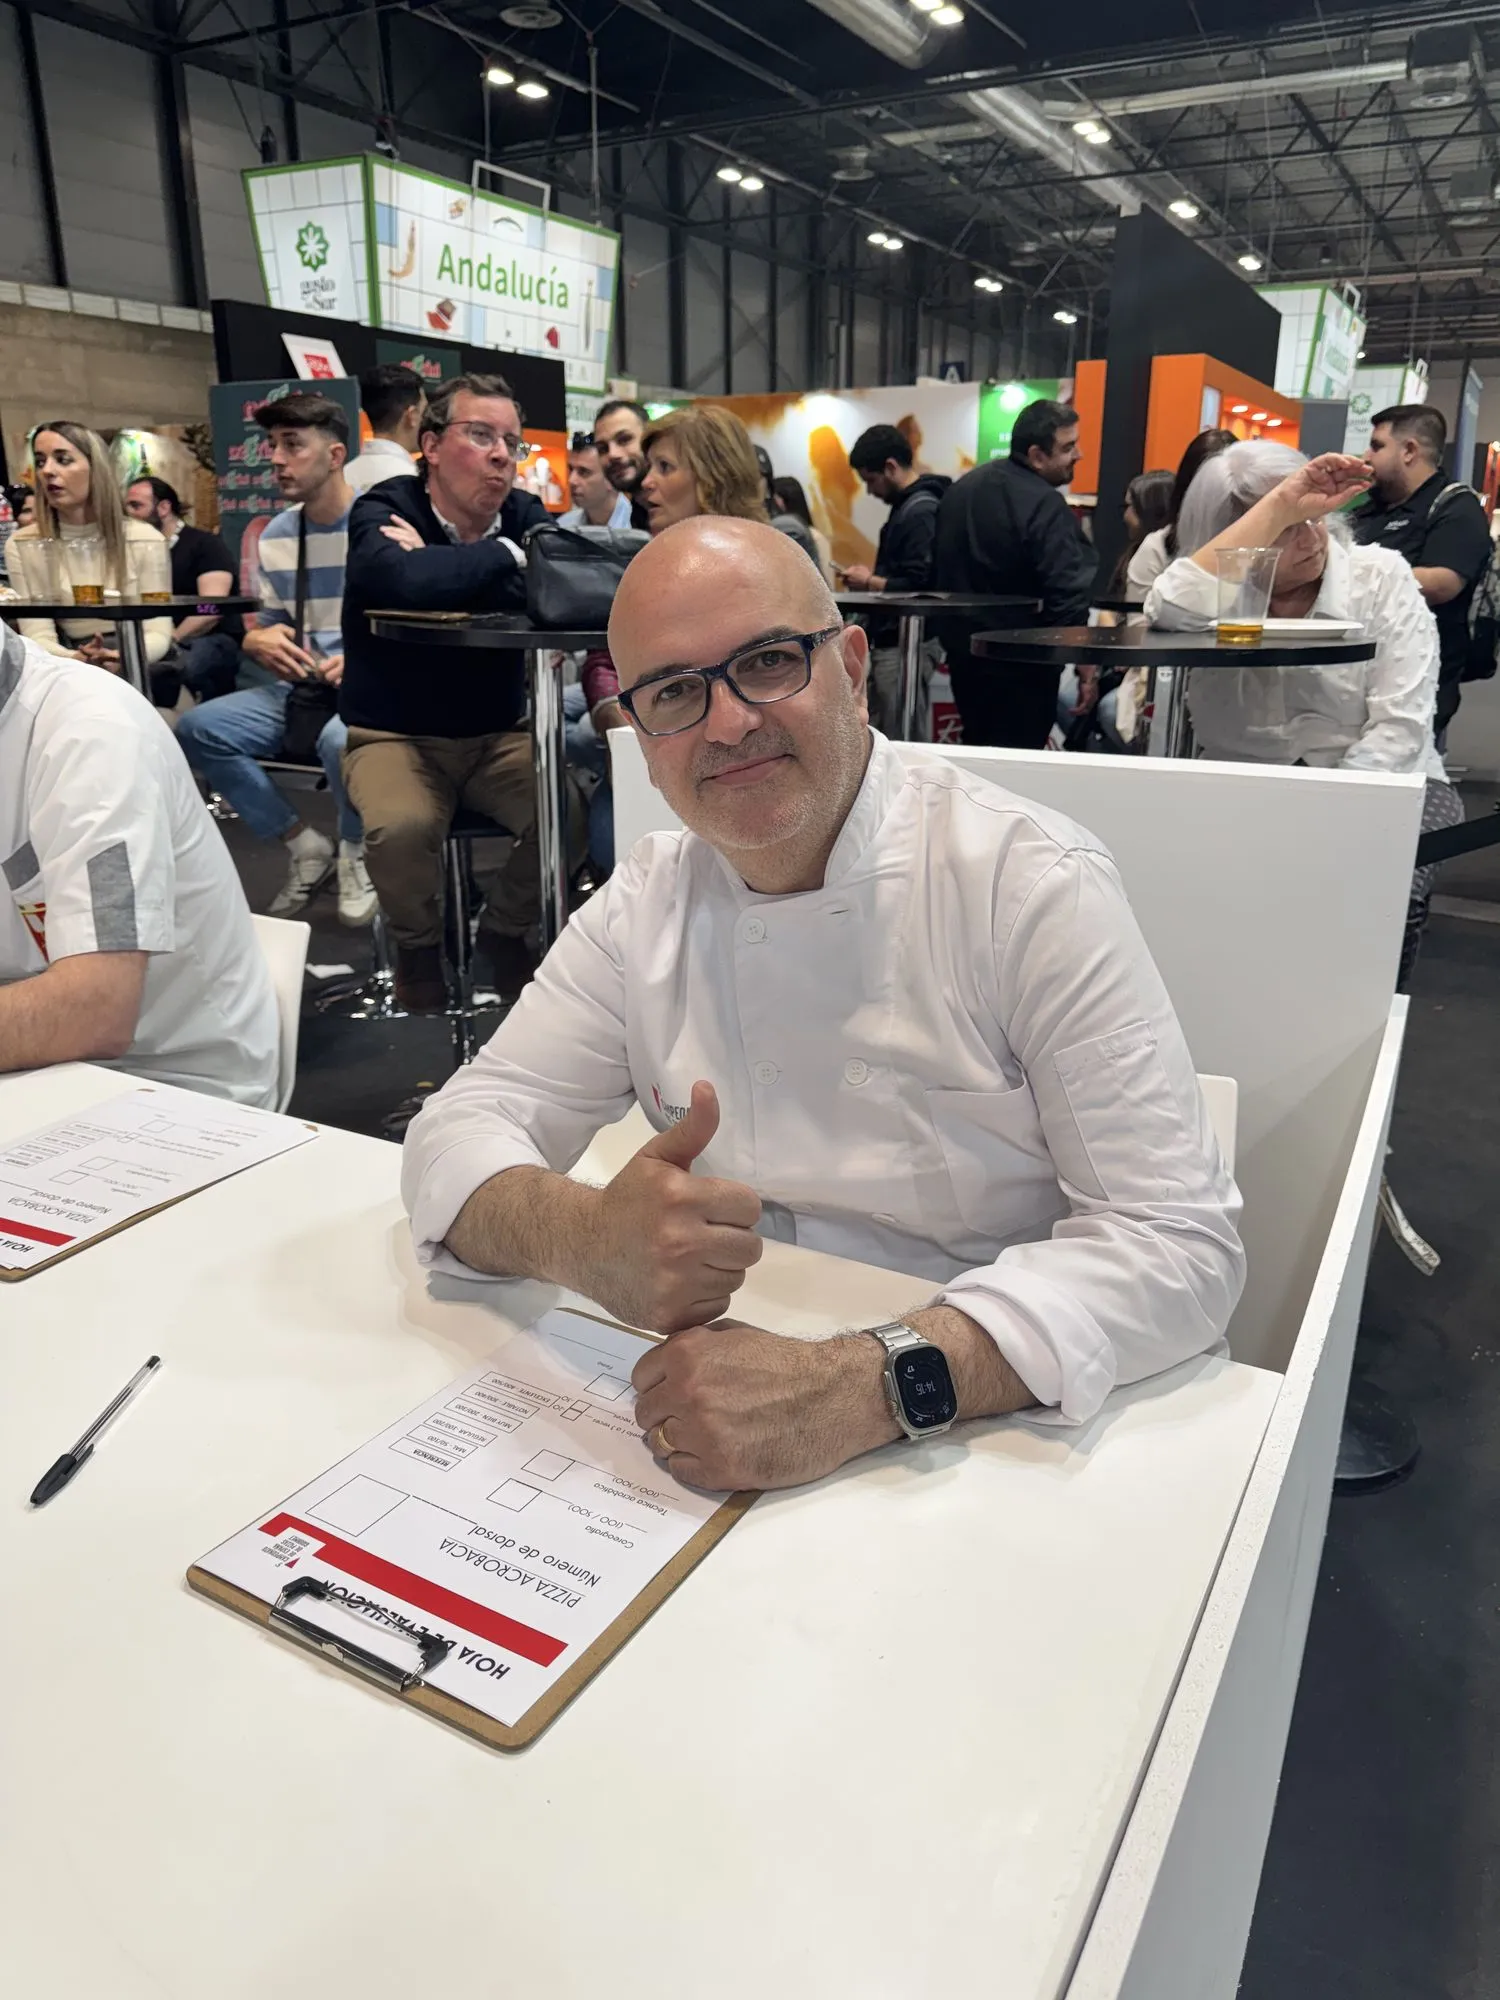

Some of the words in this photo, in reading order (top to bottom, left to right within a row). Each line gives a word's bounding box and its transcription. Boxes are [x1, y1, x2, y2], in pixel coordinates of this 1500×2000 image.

[437, 244, 569, 308] Andalucía
[64, 1212, 95, 1224] PIZZA
[1, 1240, 34, 1253] HOJA
[519, 1388, 551, 1403] EXCELENTE
[502, 1401, 529, 1415] NOTABLE
[459, 1427, 487, 1442] REGULAR
[413, 1448, 450, 1467] REFERENCIA
[453, 1444, 467, 1454] MAL
[593, 1482, 636, 1501] acrobática
[636, 1499, 668, 1516] Técnica
[467, 1525, 516, 1550] dorsal
[585, 1525, 634, 1549] Coreografía
[518, 1545, 540, 1560] de
[439, 1538, 536, 1587] ACROBACIA
[542, 1554, 602, 1588] Número
[534, 1579, 582, 1608] PIZZA
[458, 1646, 511, 1680] HOJA
